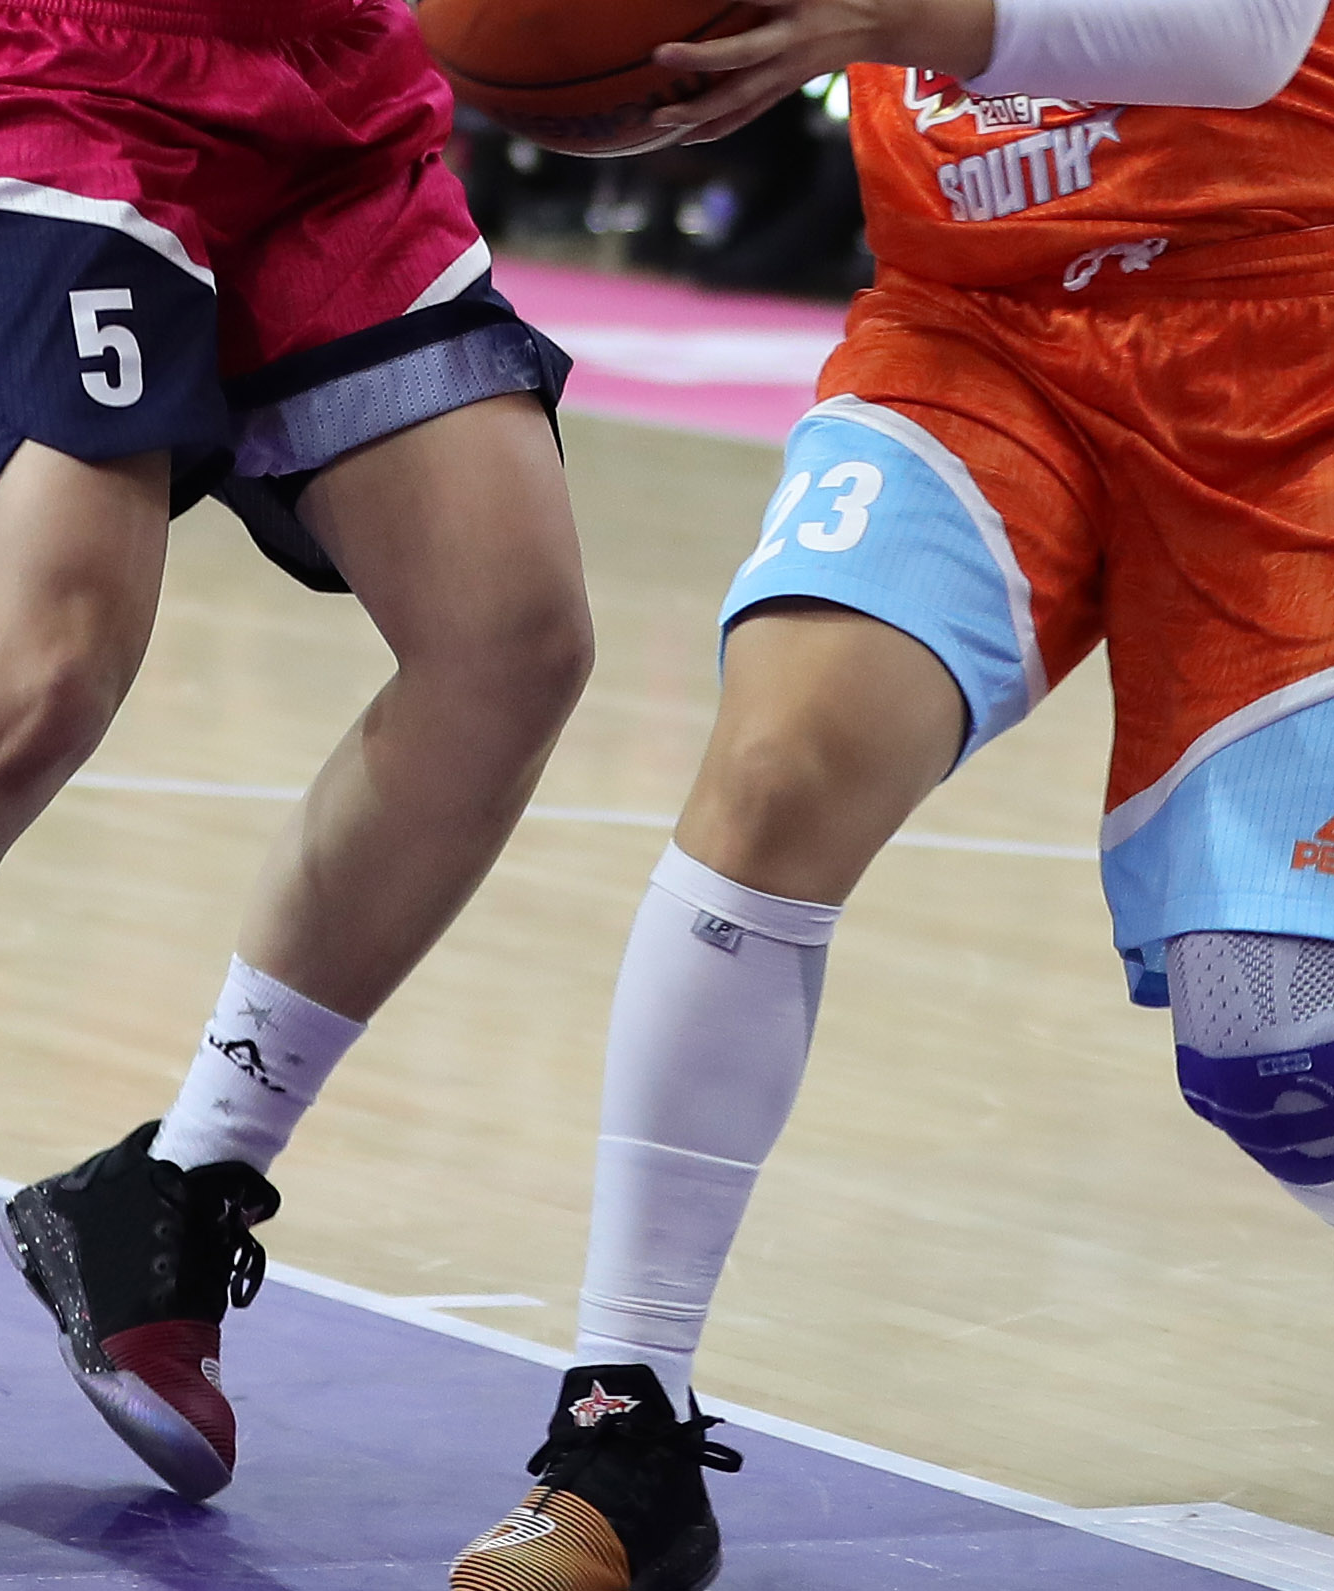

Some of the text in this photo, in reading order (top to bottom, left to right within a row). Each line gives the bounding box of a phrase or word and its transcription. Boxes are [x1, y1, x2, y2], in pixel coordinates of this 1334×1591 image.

[979, 95, 1031, 127] 2019
[937, 122, 1094, 222] SOUTH
[69, 288, 144, 408] 5
[743, 461, 884, 578] 23
